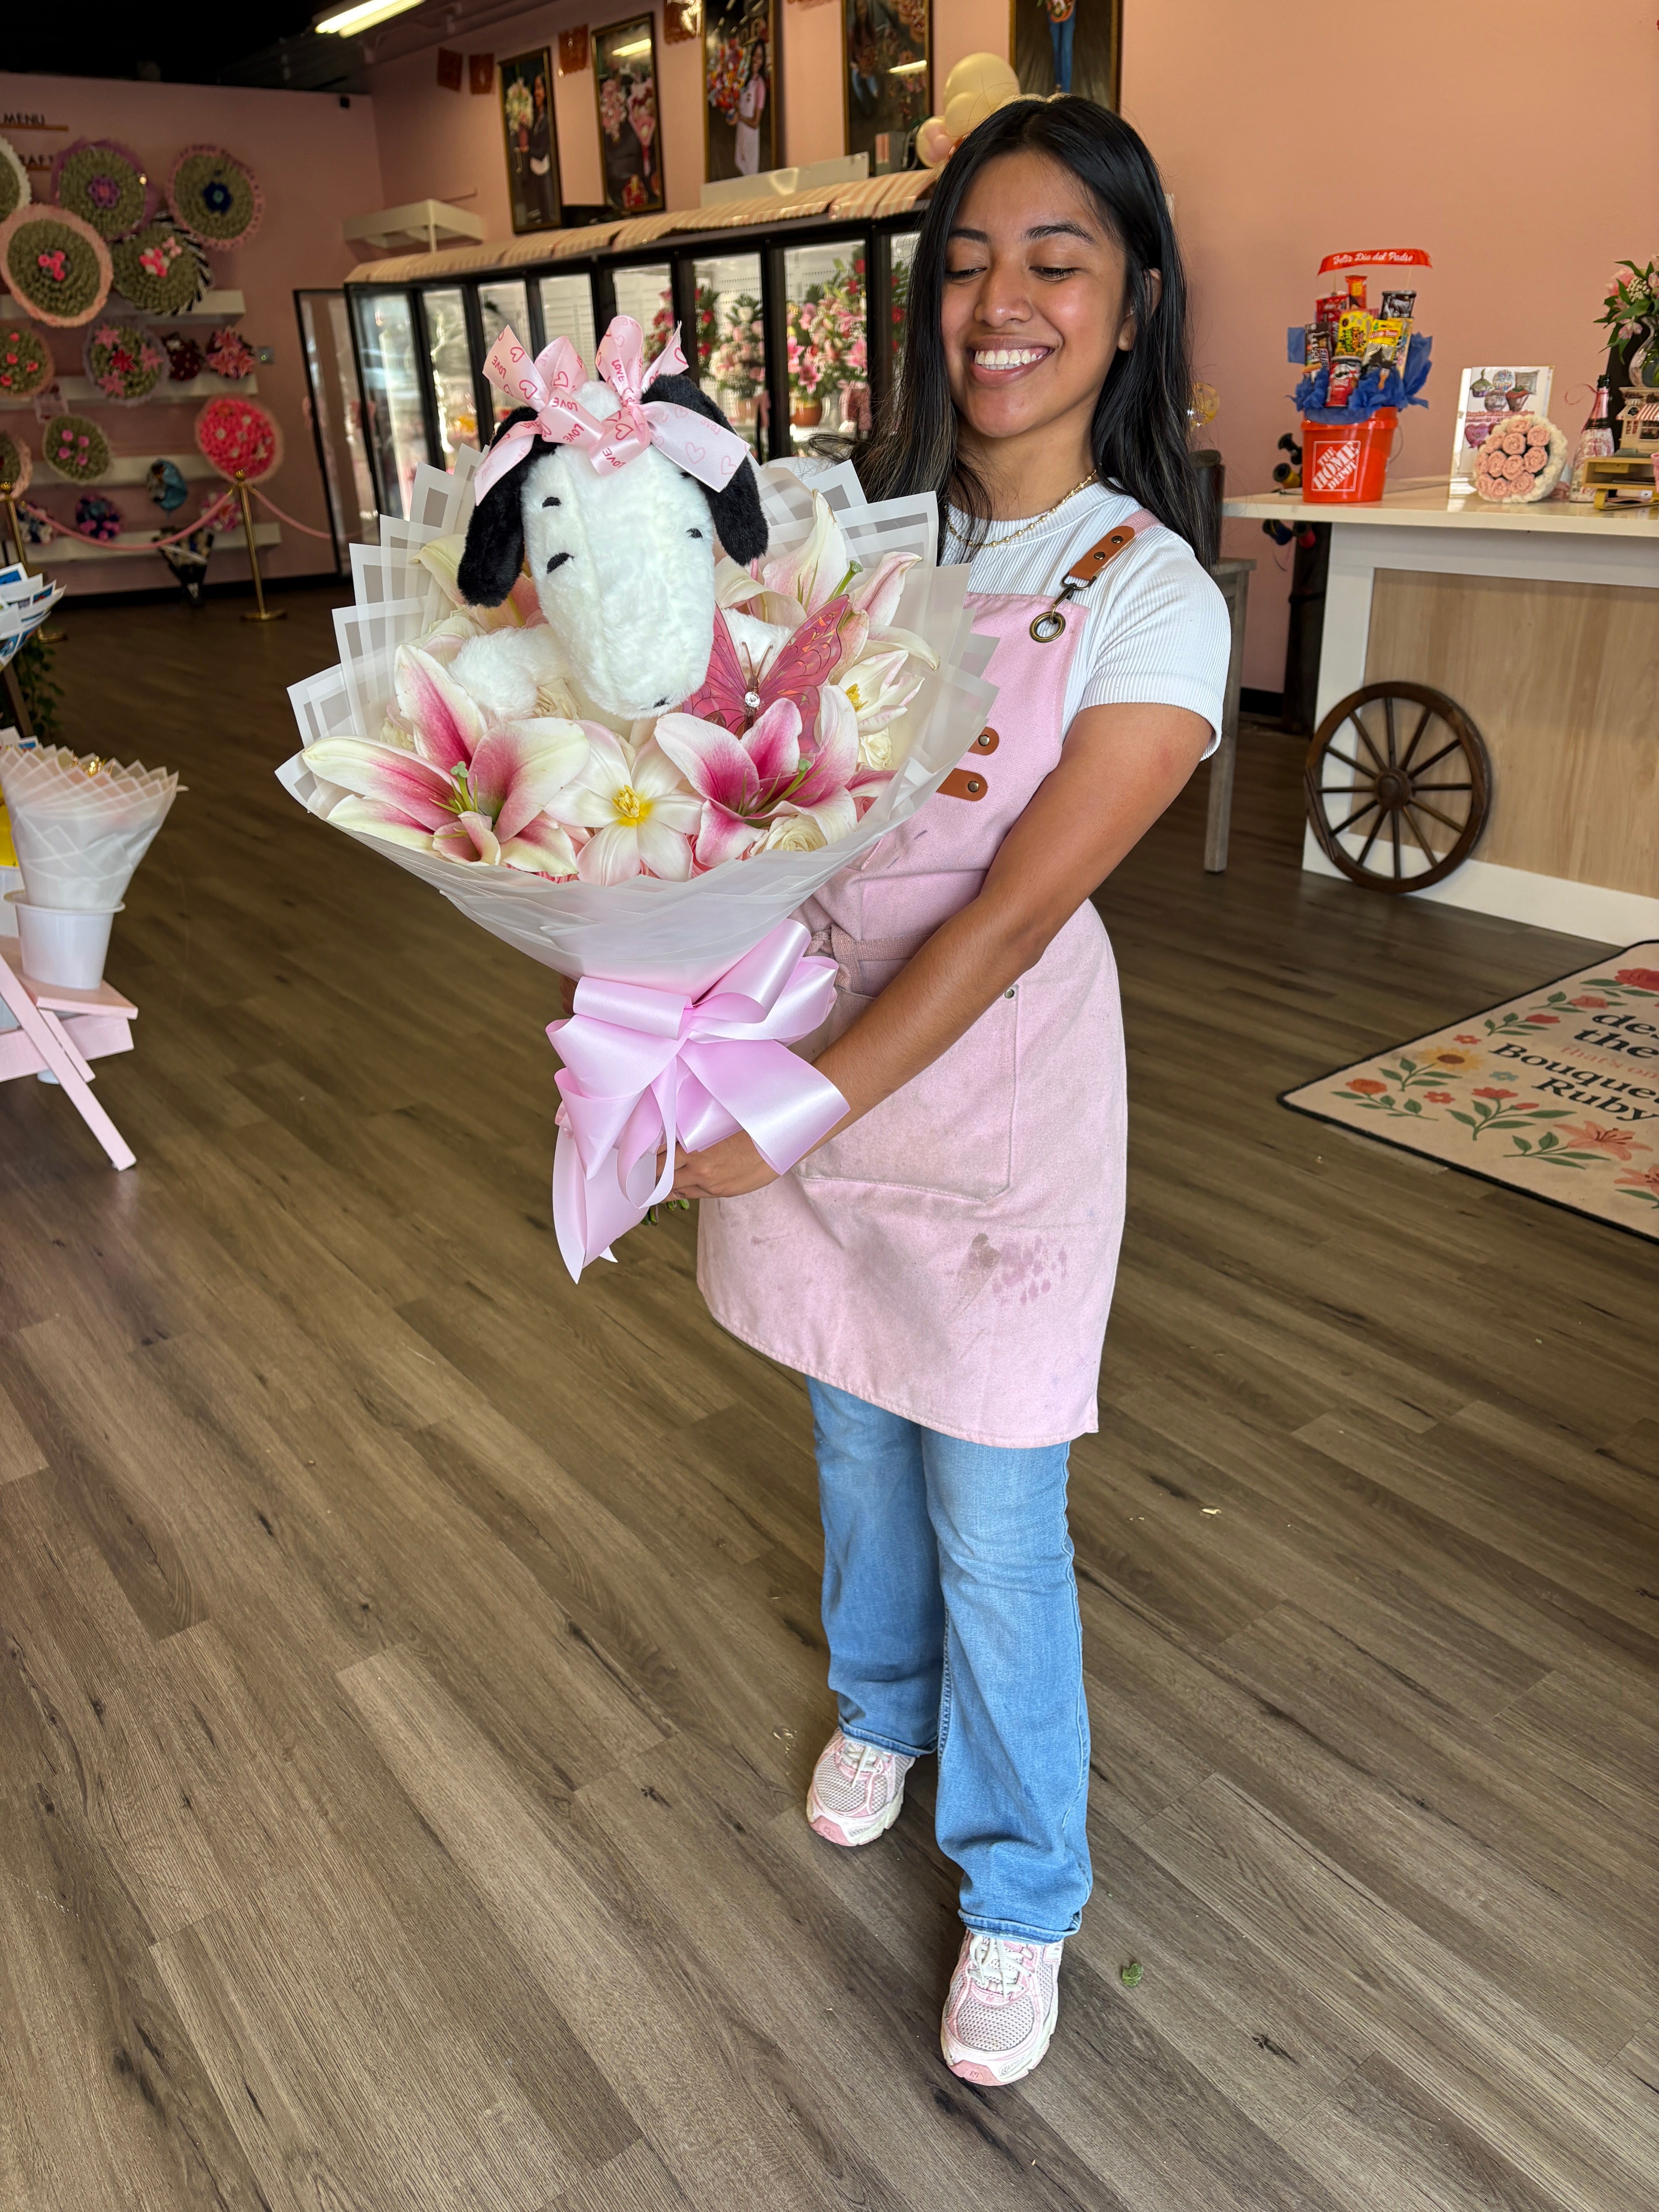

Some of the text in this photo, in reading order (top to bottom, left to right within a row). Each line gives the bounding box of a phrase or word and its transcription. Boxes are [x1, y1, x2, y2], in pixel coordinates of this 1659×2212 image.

[1388, 252, 1413, 261] Padre
[492, 356, 506, 379] LOVE
[612, 359, 625, 383] LOVE
[551, 397, 578, 412] LOVE
[520, 420, 540, 429] LOVE
[563, 423, 584, 442] LOVE
[603, 447, 626, 468] LOVE
[1312, 441, 1359, 489] HOME
[1317, 446, 1336, 466] THE
[1327, 459, 1357, 490] DEPOT
[1574, 1029, 1659, 1059] the
[1488, 1042, 1659, 1104] Bouque
[1531, 1077, 1659, 1121] Ruby
